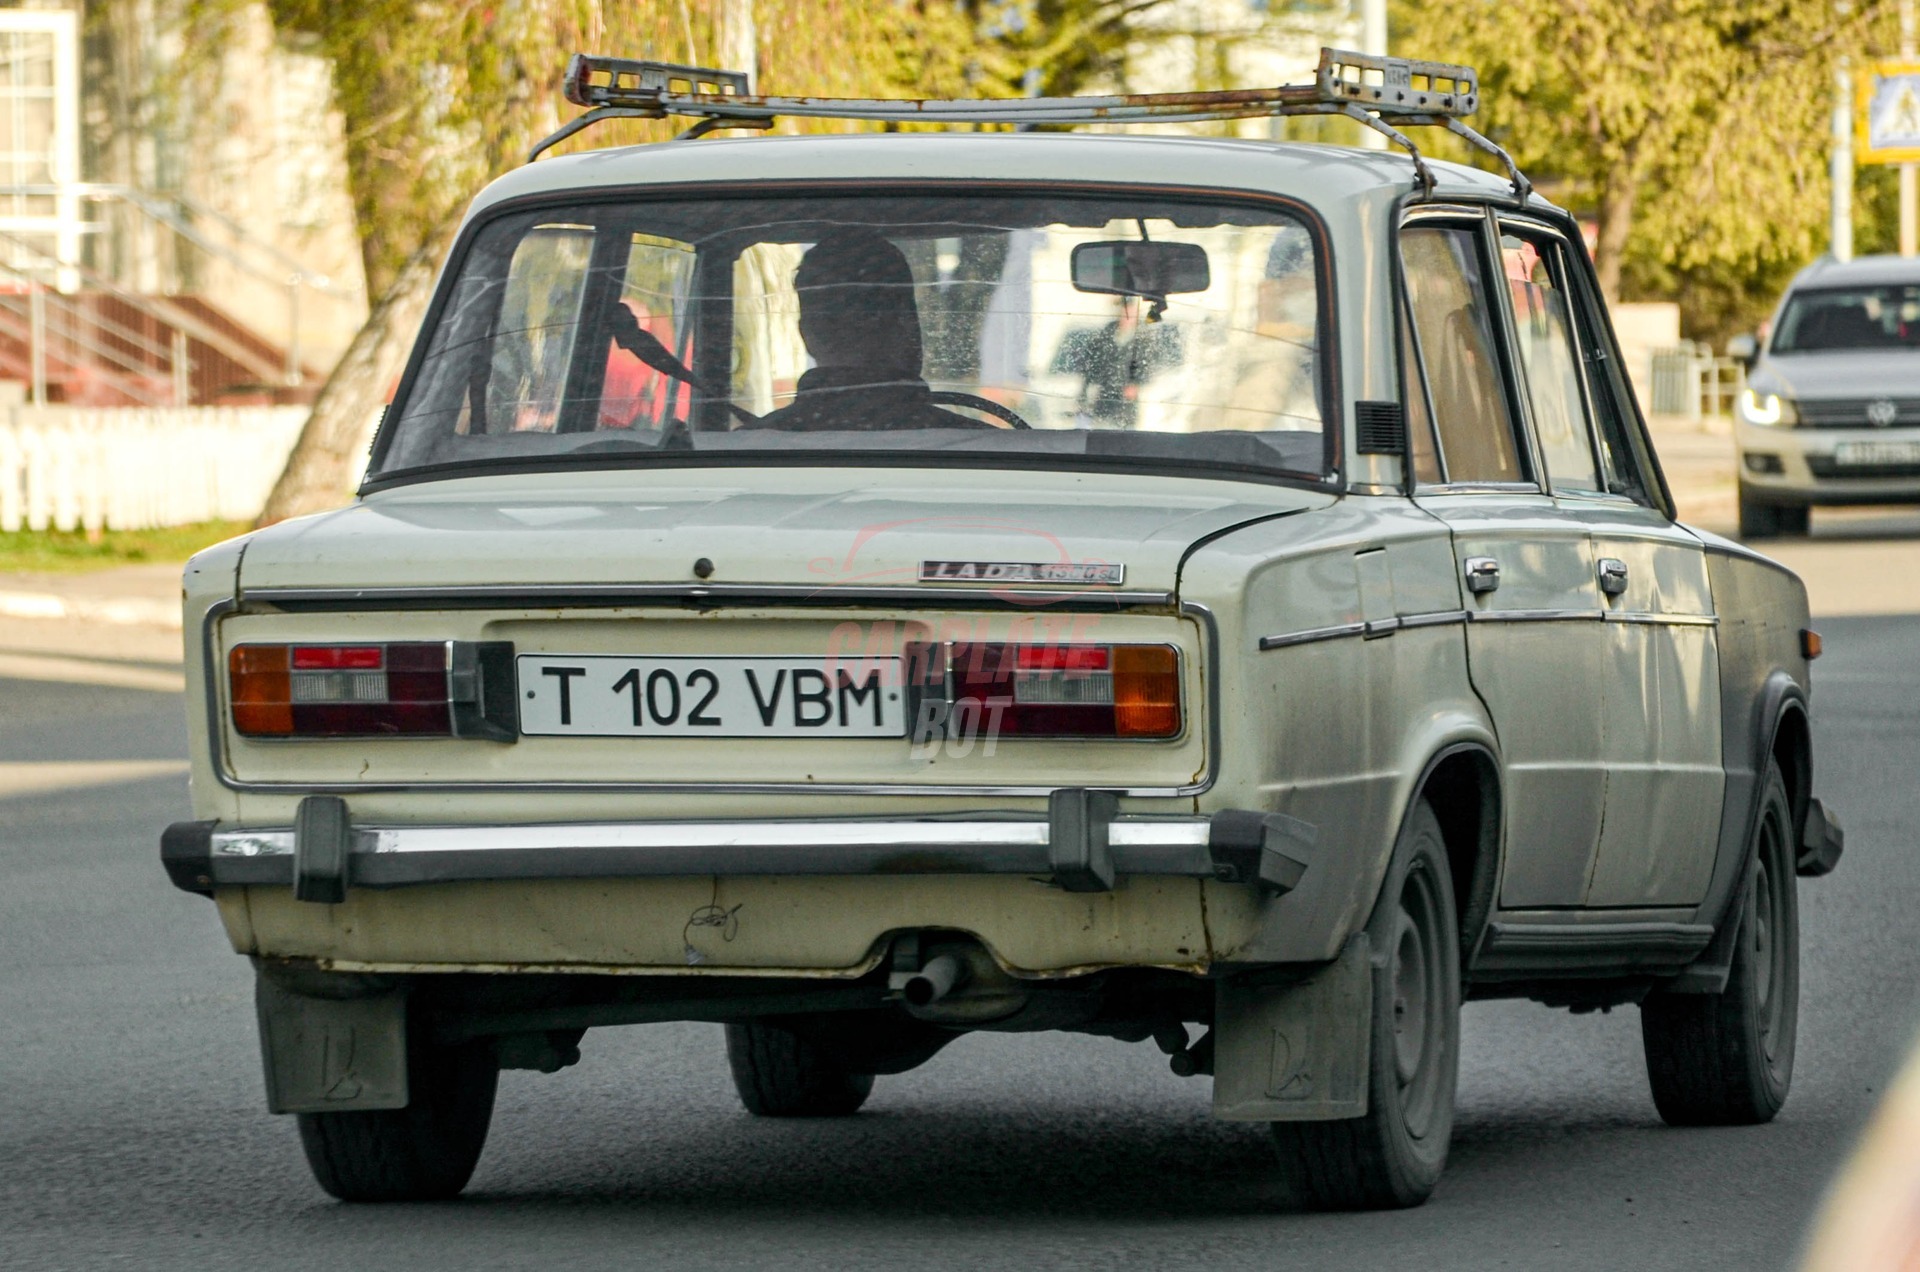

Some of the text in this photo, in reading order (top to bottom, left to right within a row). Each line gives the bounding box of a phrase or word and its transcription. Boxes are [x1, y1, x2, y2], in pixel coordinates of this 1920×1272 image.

[934, 562, 1036, 579] LADA
[541, 666, 883, 727] T 102 VBM
